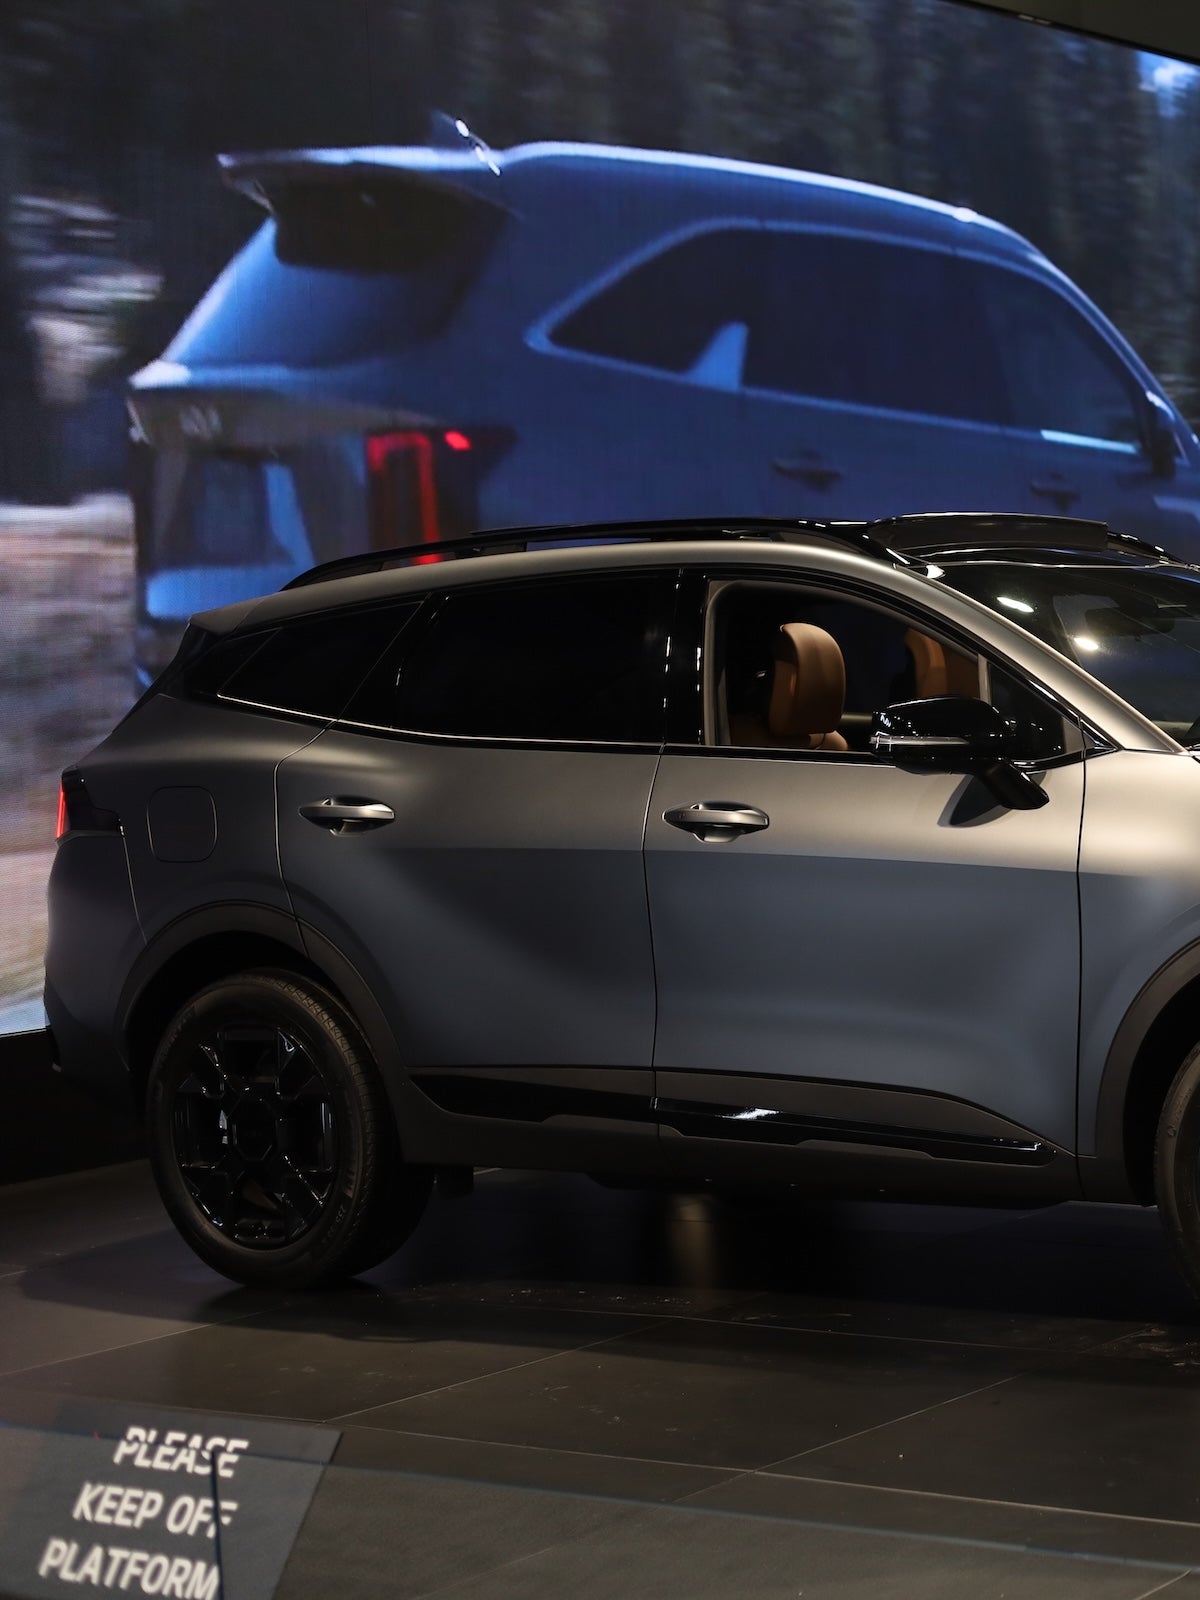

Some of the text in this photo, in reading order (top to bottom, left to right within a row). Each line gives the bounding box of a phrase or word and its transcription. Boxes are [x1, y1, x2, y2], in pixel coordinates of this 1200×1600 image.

[113, 1426, 249, 1478] PLEASE
[72, 1482, 239, 1539] KEEP OFF
[38, 1537, 220, 1600] PLATFORM
